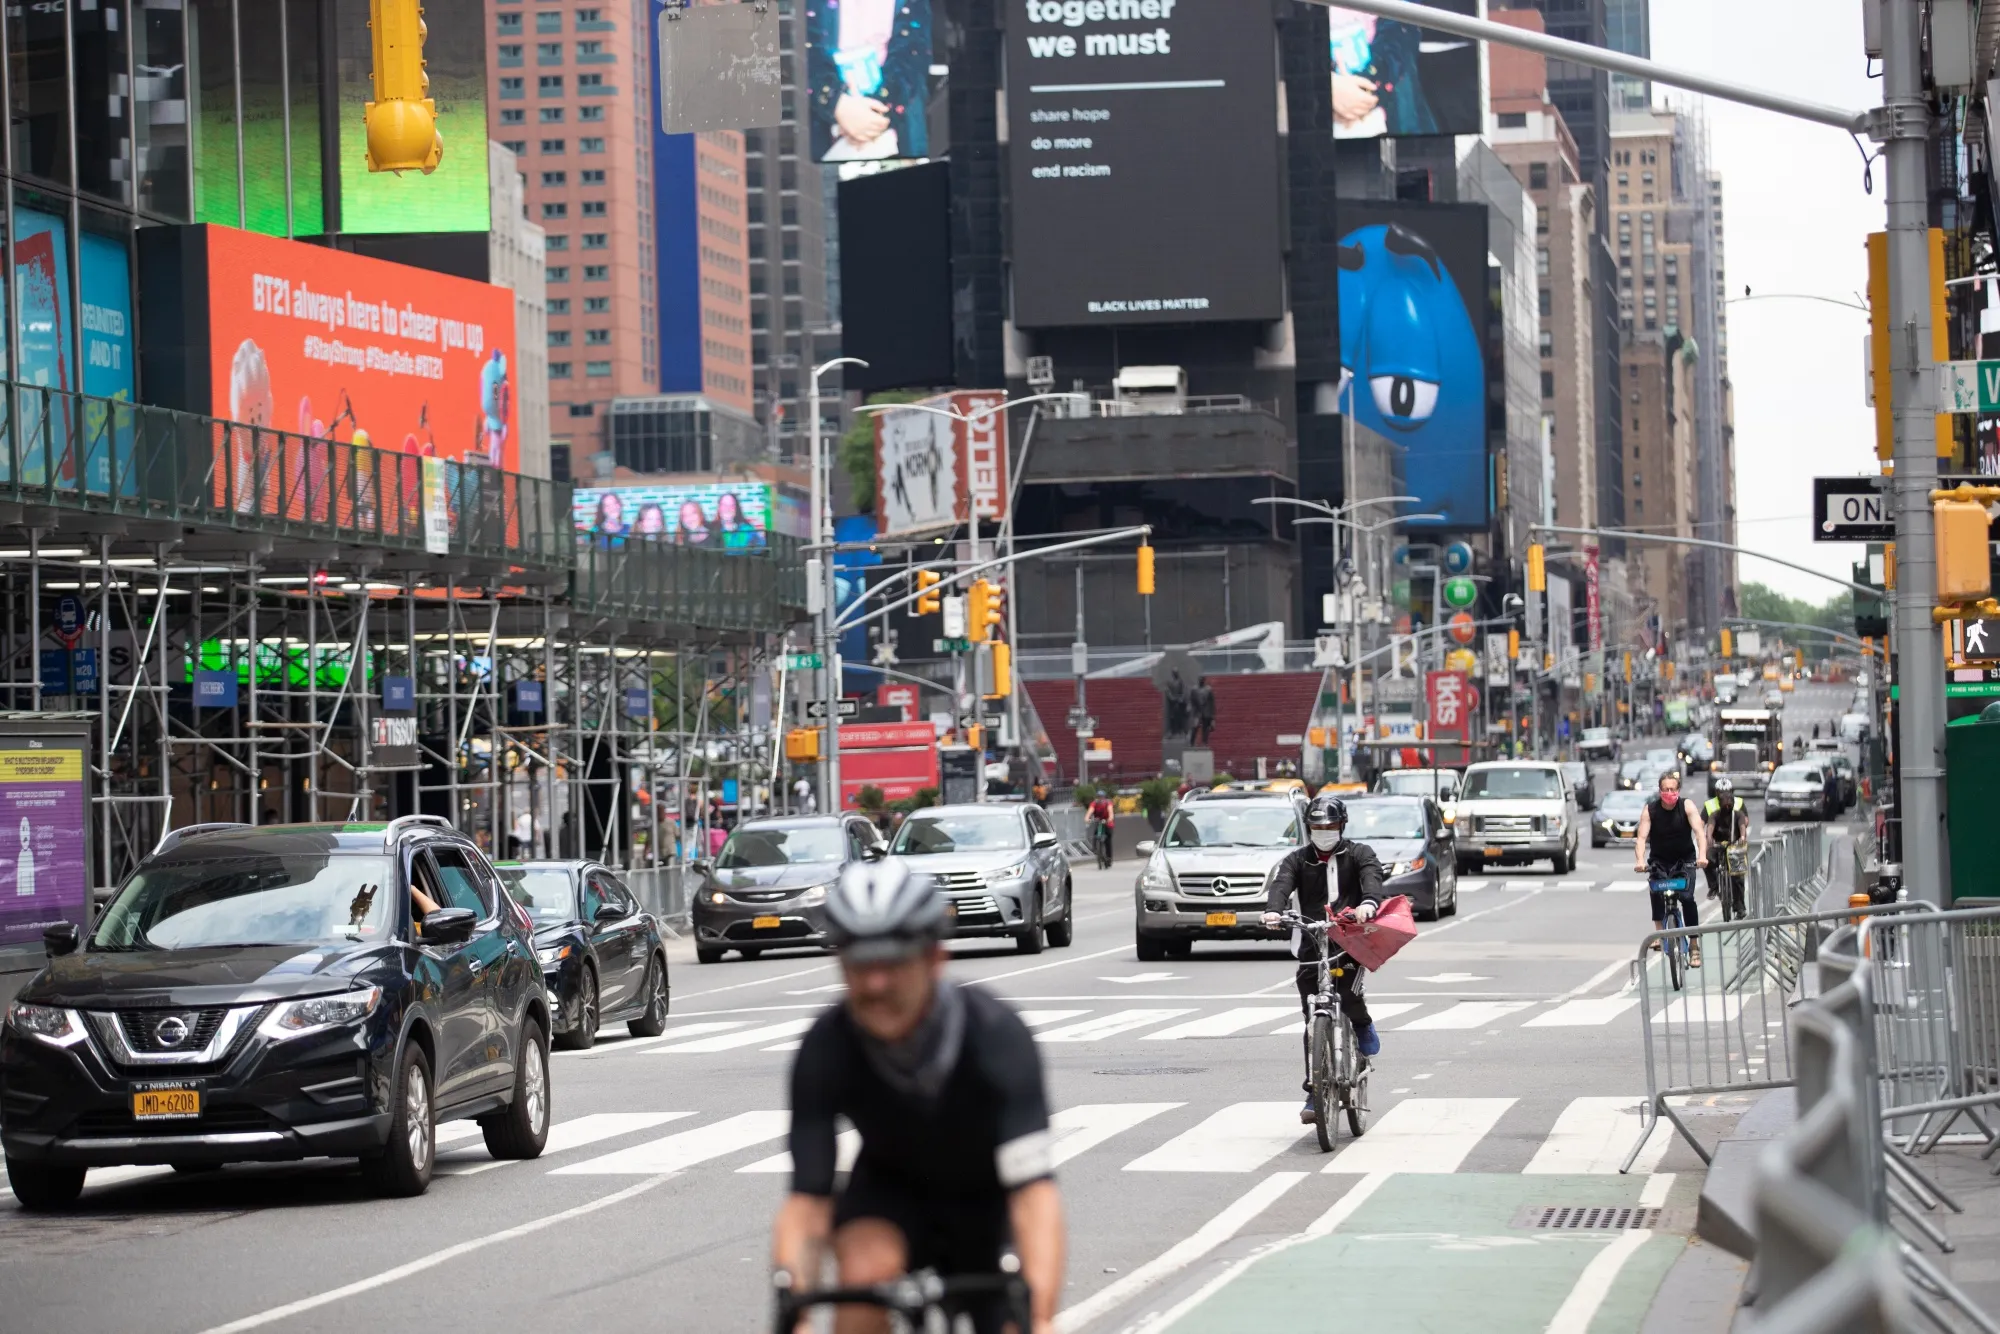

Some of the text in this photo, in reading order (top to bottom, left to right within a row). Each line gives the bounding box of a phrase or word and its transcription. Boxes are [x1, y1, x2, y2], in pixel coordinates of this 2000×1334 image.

[1025, 0, 1176, 27] together
[1027, 28, 1171, 58] we must
[1030, 108, 1111, 123] share hope
[1031, 137, 1093, 150] do more
[1032, 163, 1111, 178] end racism
[253, 273, 484, 358] BT21 always here to cheer you up
[1087, 297, 1209, 312] BLACK LIVES MATTER
[82, 303, 125, 337] REUNITED
[89, 339, 110, 368] AND
[1436, 674, 1462, 726] tkts
[386, 717, 418, 746] TISSOT
[149, 1081, 183, 1089] NISSAN
[140, 1093, 195, 1114] JMD 6208
